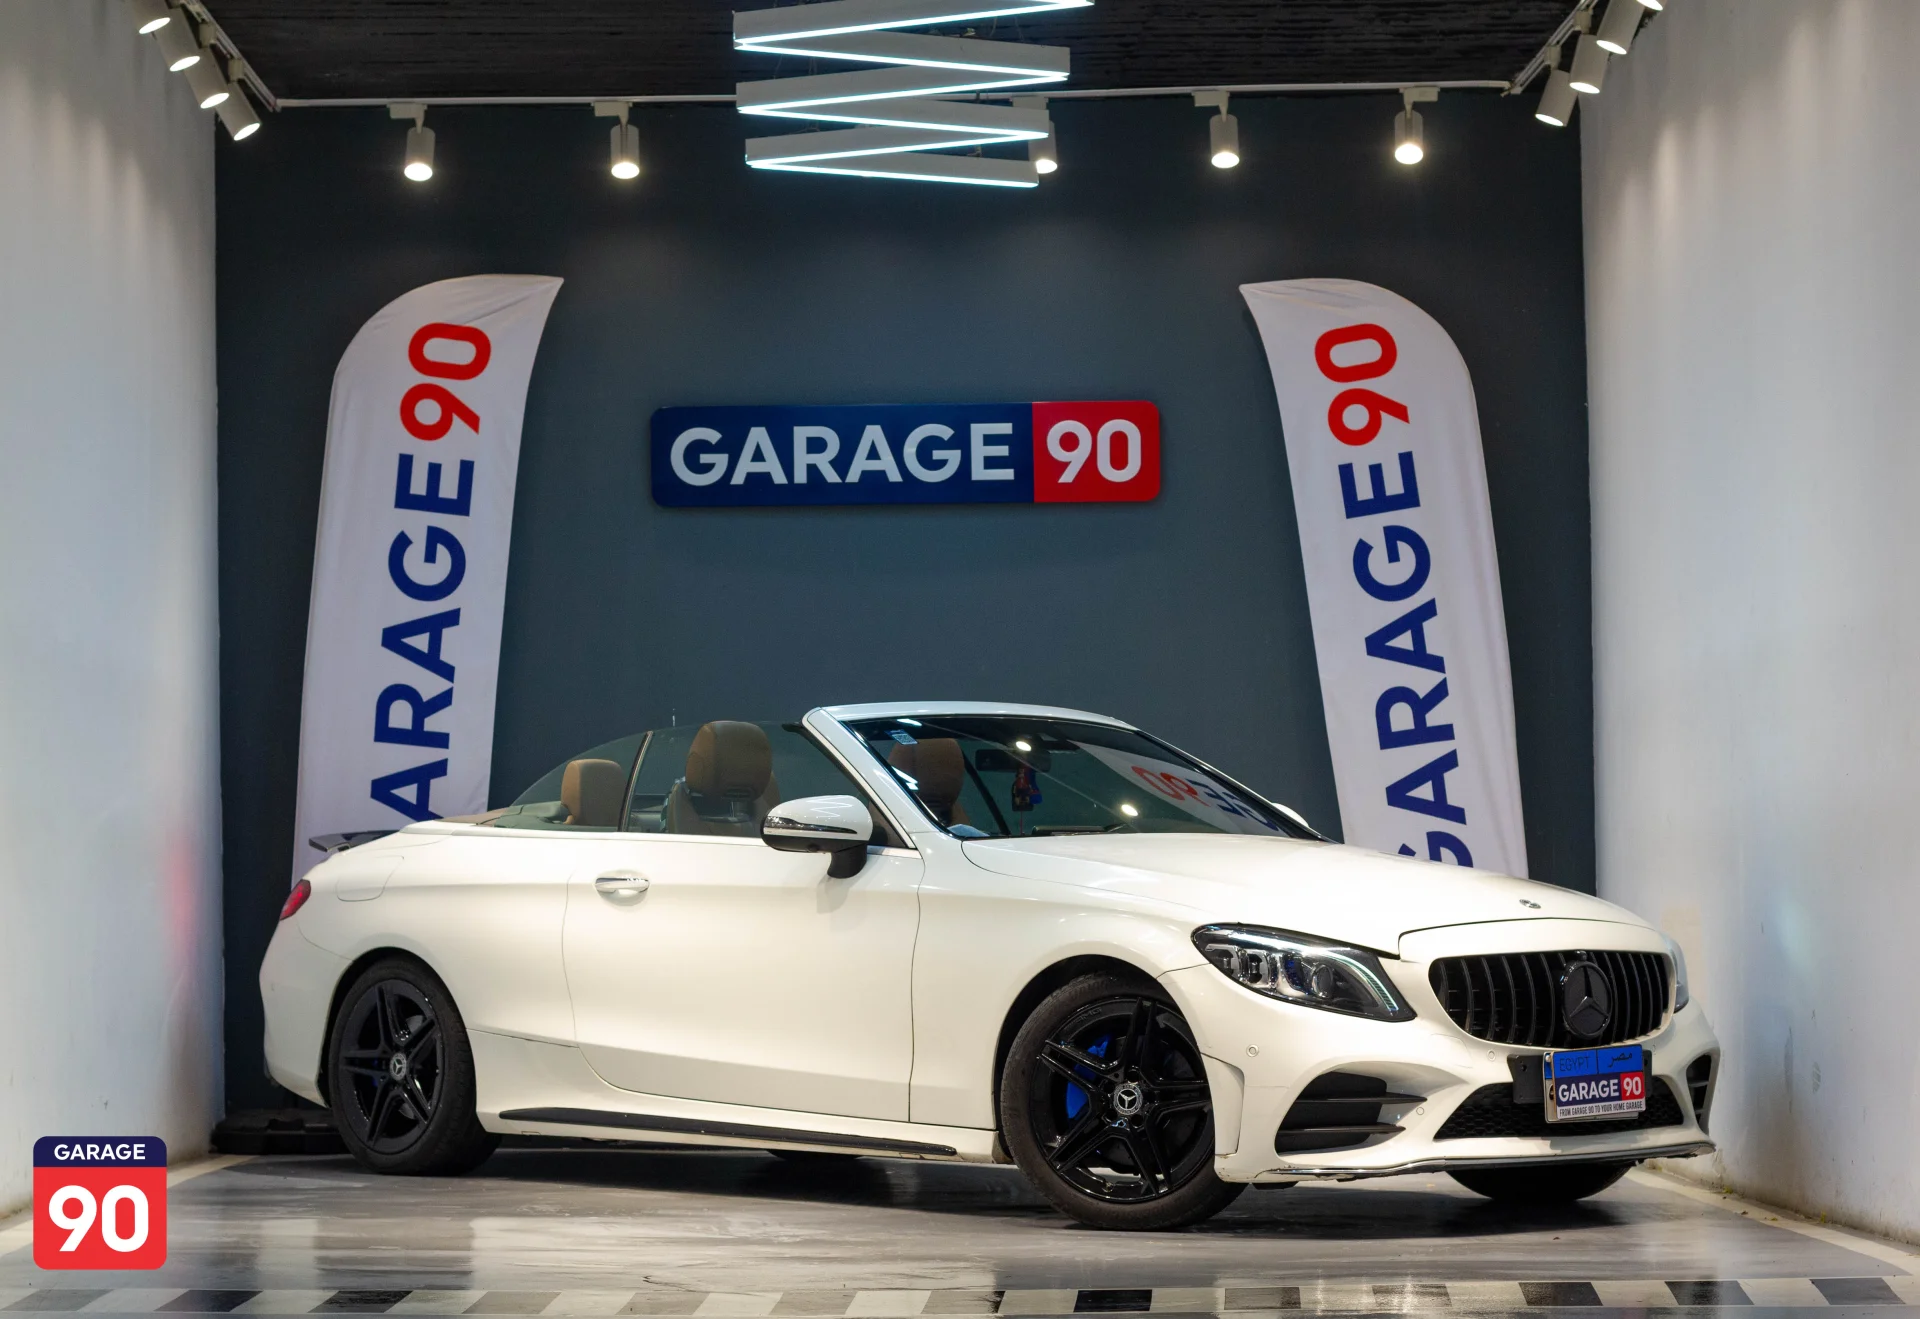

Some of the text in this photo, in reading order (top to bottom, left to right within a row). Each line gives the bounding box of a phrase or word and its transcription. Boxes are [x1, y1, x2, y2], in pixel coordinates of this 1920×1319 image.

[670, 419, 1142, 487] GARAGE 90
[1560, 1056, 1591, 1072] EGYPT
[1608, 1052, 1633, 1068] مصر
[1558, 1076, 1642, 1102] GARAGE 90
[1560, 1101, 1643, 1117] FROM GARAGE 90 TO YOUR HOME GARAGE
